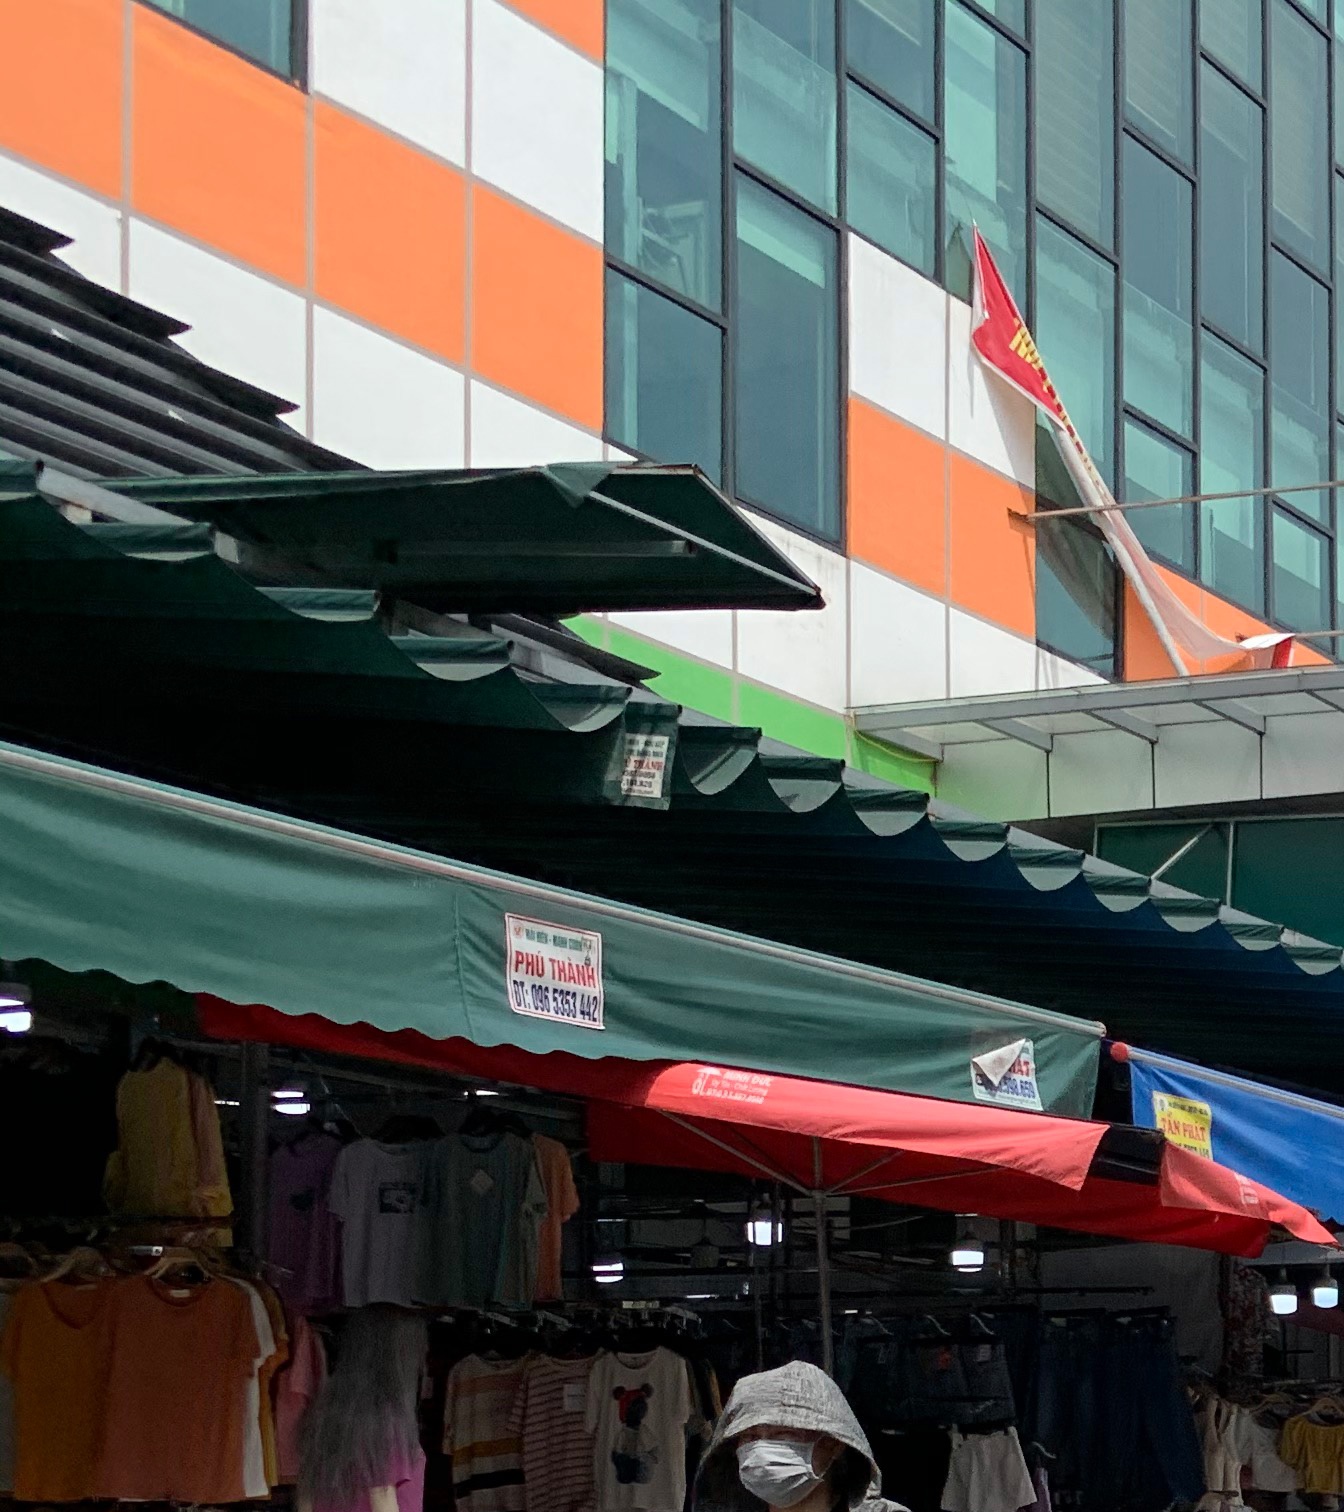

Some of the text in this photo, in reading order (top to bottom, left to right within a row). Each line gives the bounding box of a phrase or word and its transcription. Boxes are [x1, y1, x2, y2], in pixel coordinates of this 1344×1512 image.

[514, 950, 597, 988] PHÚ THÀNH
[531, 983, 551, 1014] 096
[553, 987, 577, 1018] 5353
[580, 992, 598, 1022] 442
